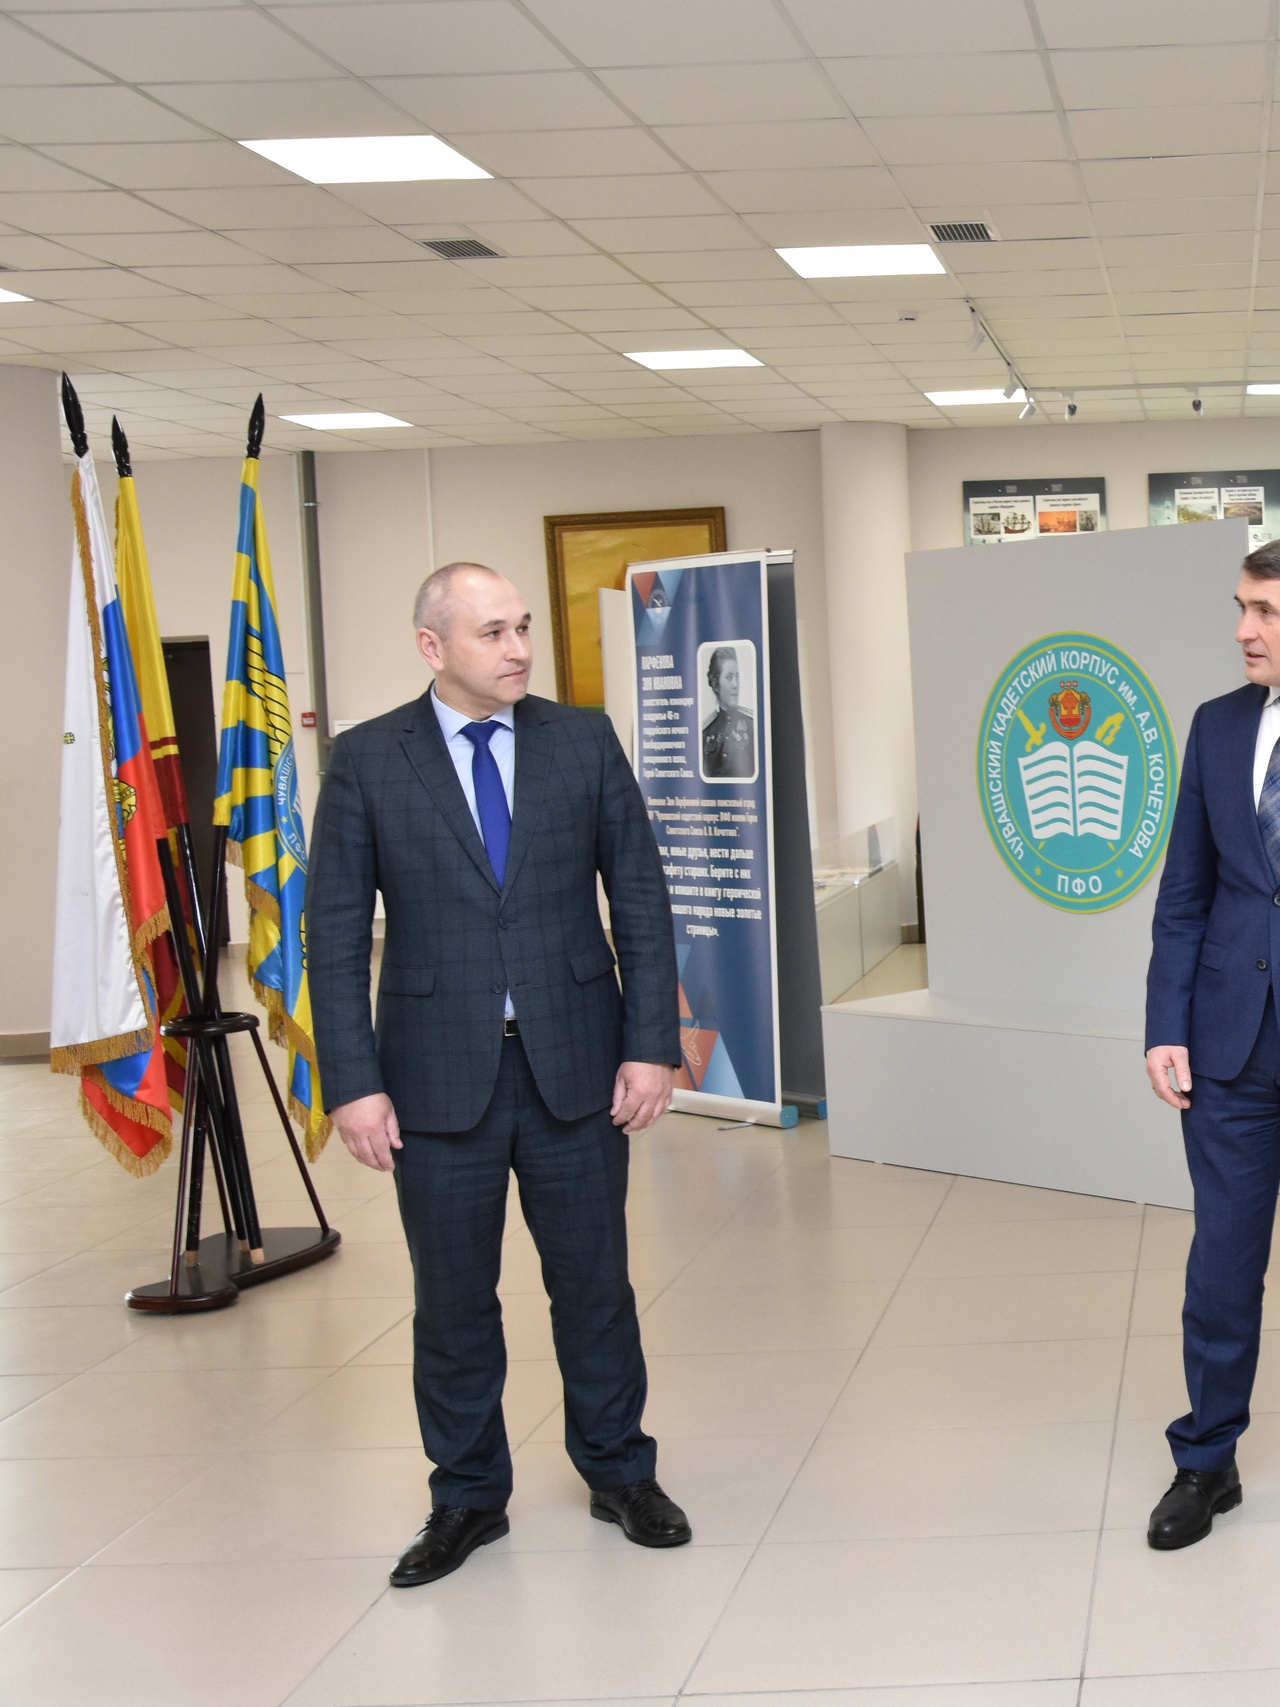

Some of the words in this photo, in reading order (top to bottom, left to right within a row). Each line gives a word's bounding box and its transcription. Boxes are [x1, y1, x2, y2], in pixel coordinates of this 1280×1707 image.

[992, 649, 1057, 737] КАДЕТСКИЙ
[1060, 650, 1120, 685] КОРПУС
[277, 752, 295, 805] ЧУВАШС
[986, 740, 1025, 861] ЧУВАШСКИЙ
[1128, 752, 1165, 860] КОЧЕТОВА
[1056, 873, 1103, 896] ПФО
